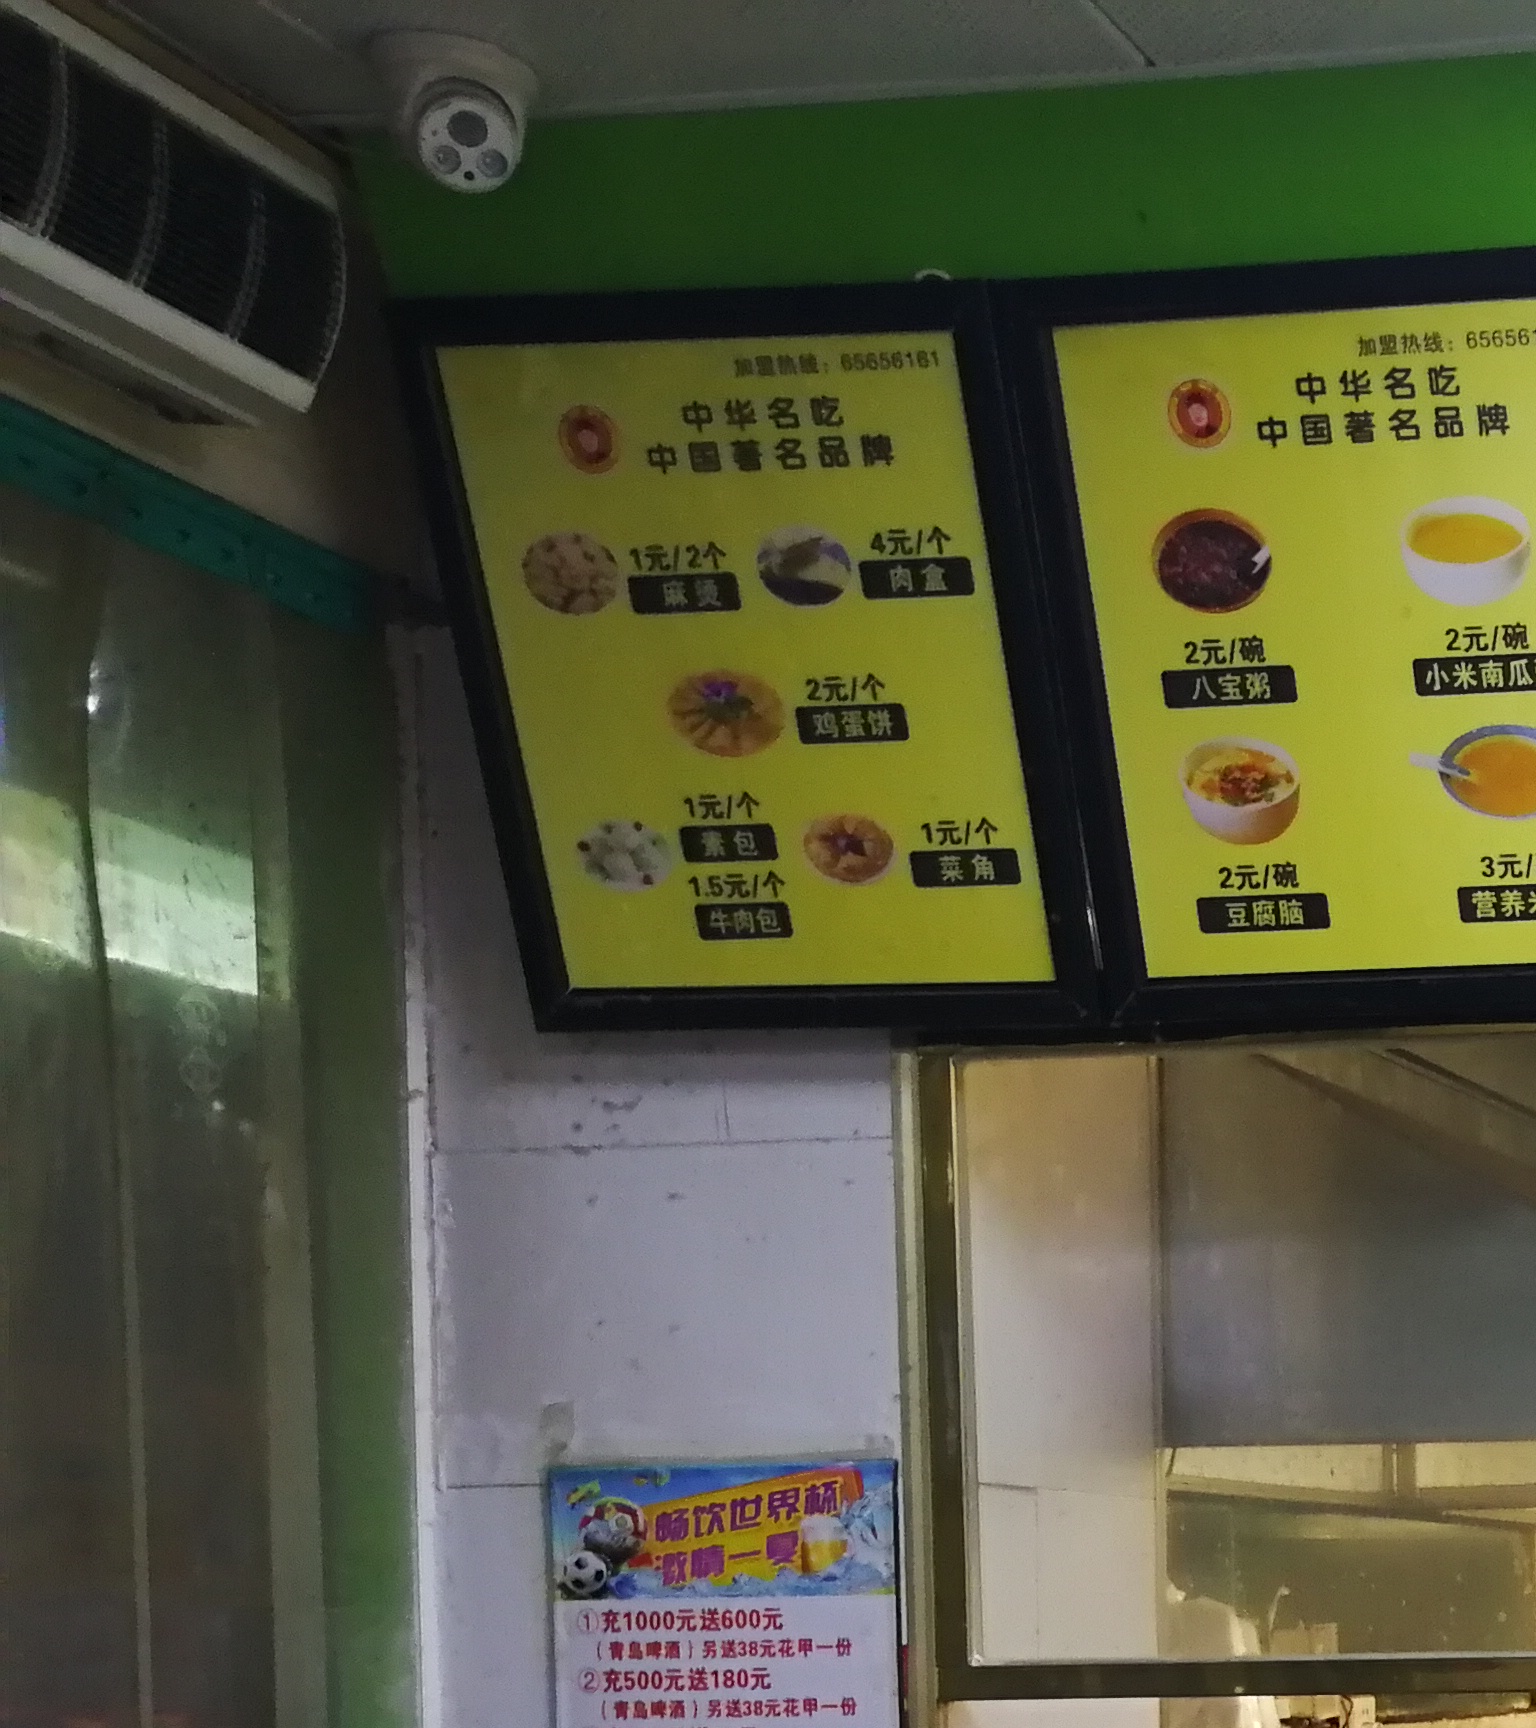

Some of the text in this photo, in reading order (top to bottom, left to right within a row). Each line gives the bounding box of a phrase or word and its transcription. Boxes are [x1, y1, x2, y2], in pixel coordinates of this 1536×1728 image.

[1295, 365, 1460, 405] 中华名吃
[681, 395, 846, 433] 中华名吃
[1256, 402, 1509, 449] 中国著名品牌
[645, 432, 895, 475] 中国著名品牌
[870, 526, 951, 556] 4元/个
[630, 542, 726, 573] 1元/2个
[889, 563, 947, 596] 肉盒
[1184, 636, 1269, 667] 2元/碗
[1445, 622, 1529, 652] 2元/碗
[805, 673, 885, 702] 2元/个
[1192, 672, 1270, 700] 八宝粥
[813, 710, 893, 741] 鸡蛋饼
[683, 792, 759, 820] 1元/个
[701, 830, 758, 857] 素包
[921, 817, 997, 846] 1元/个
[939, 854, 994, 882] 菜角
[1218, 862, 1299, 890] 2元/碗
[688, 870, 785, 899] 1.5元/个
[710, 908, 781, 934] 牛肉包
[1225, 899, 1306, 931] 豆腐脑
[655, 1479, 842, 1543] 畅饮世界杯
